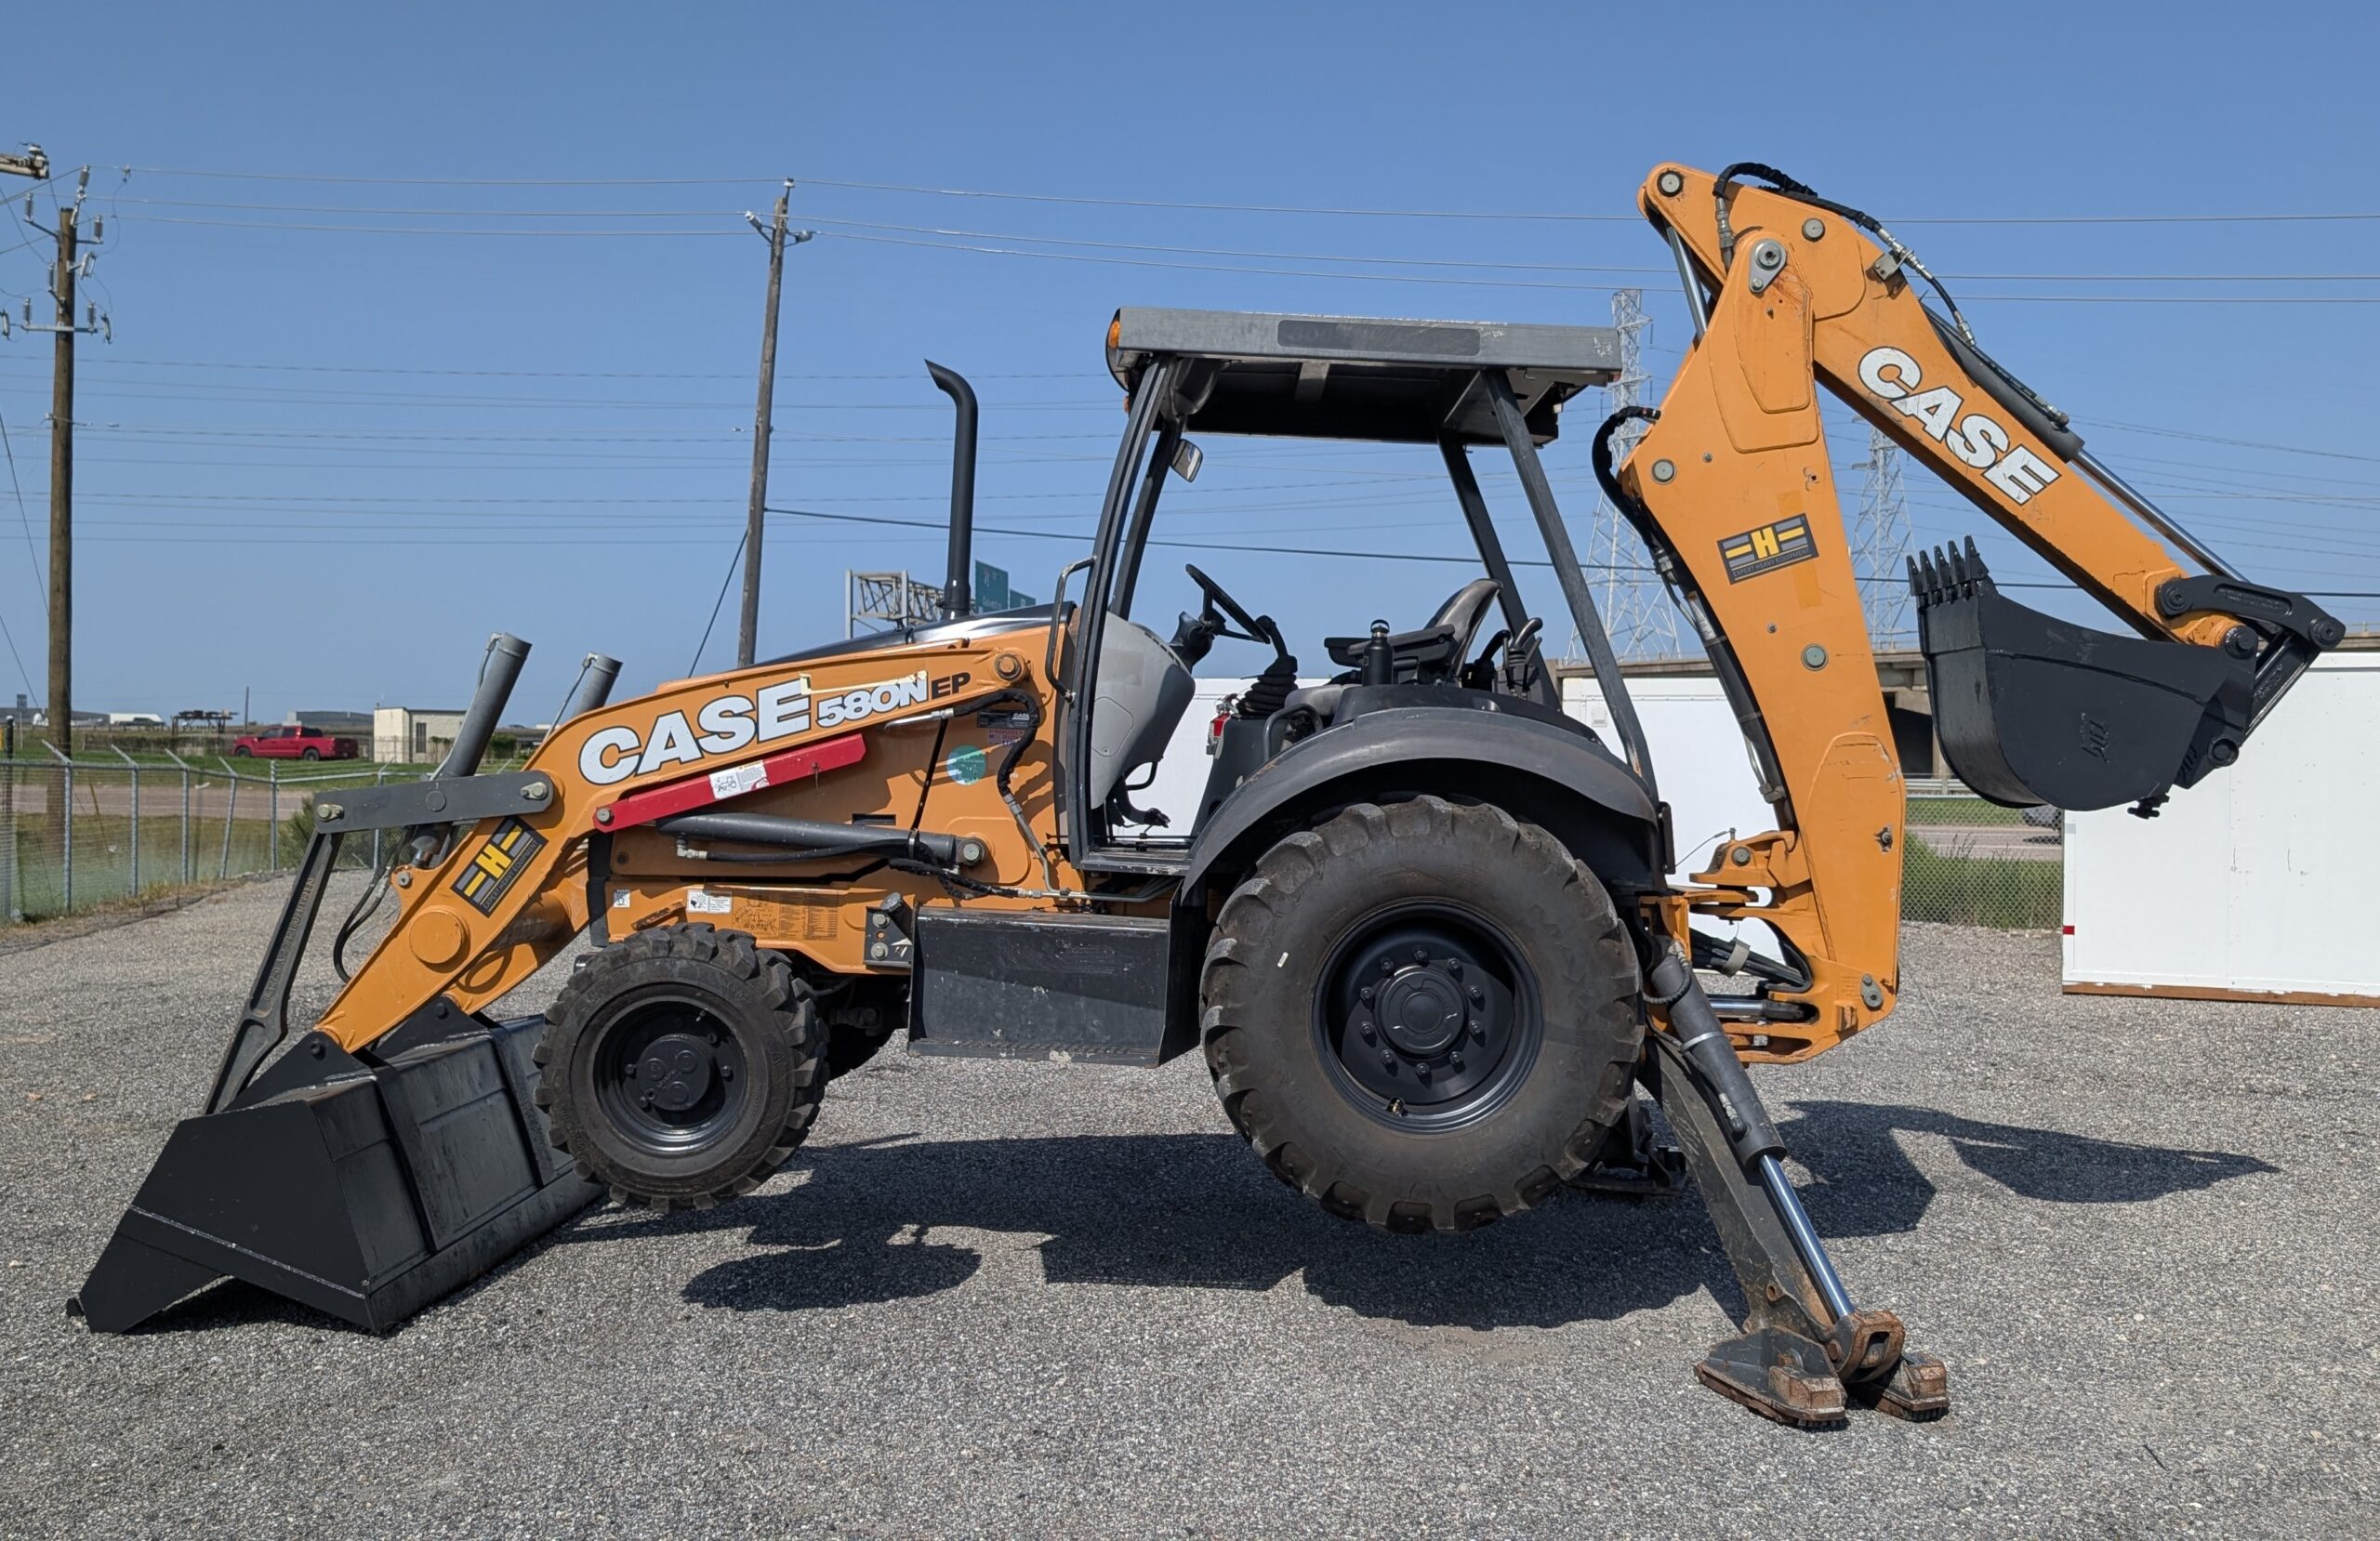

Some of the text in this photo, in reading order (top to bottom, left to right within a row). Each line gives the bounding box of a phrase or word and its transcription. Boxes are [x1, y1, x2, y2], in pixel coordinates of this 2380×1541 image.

[1858, 346, 2062, 507] CASE
[1751, 526, 1779, 560] H
[578, 678, 812, 785] CASE
[815, 673, 928, 729] 580N
[932, 672, 971, 700] EP
[475, 843, 512, 879] H
